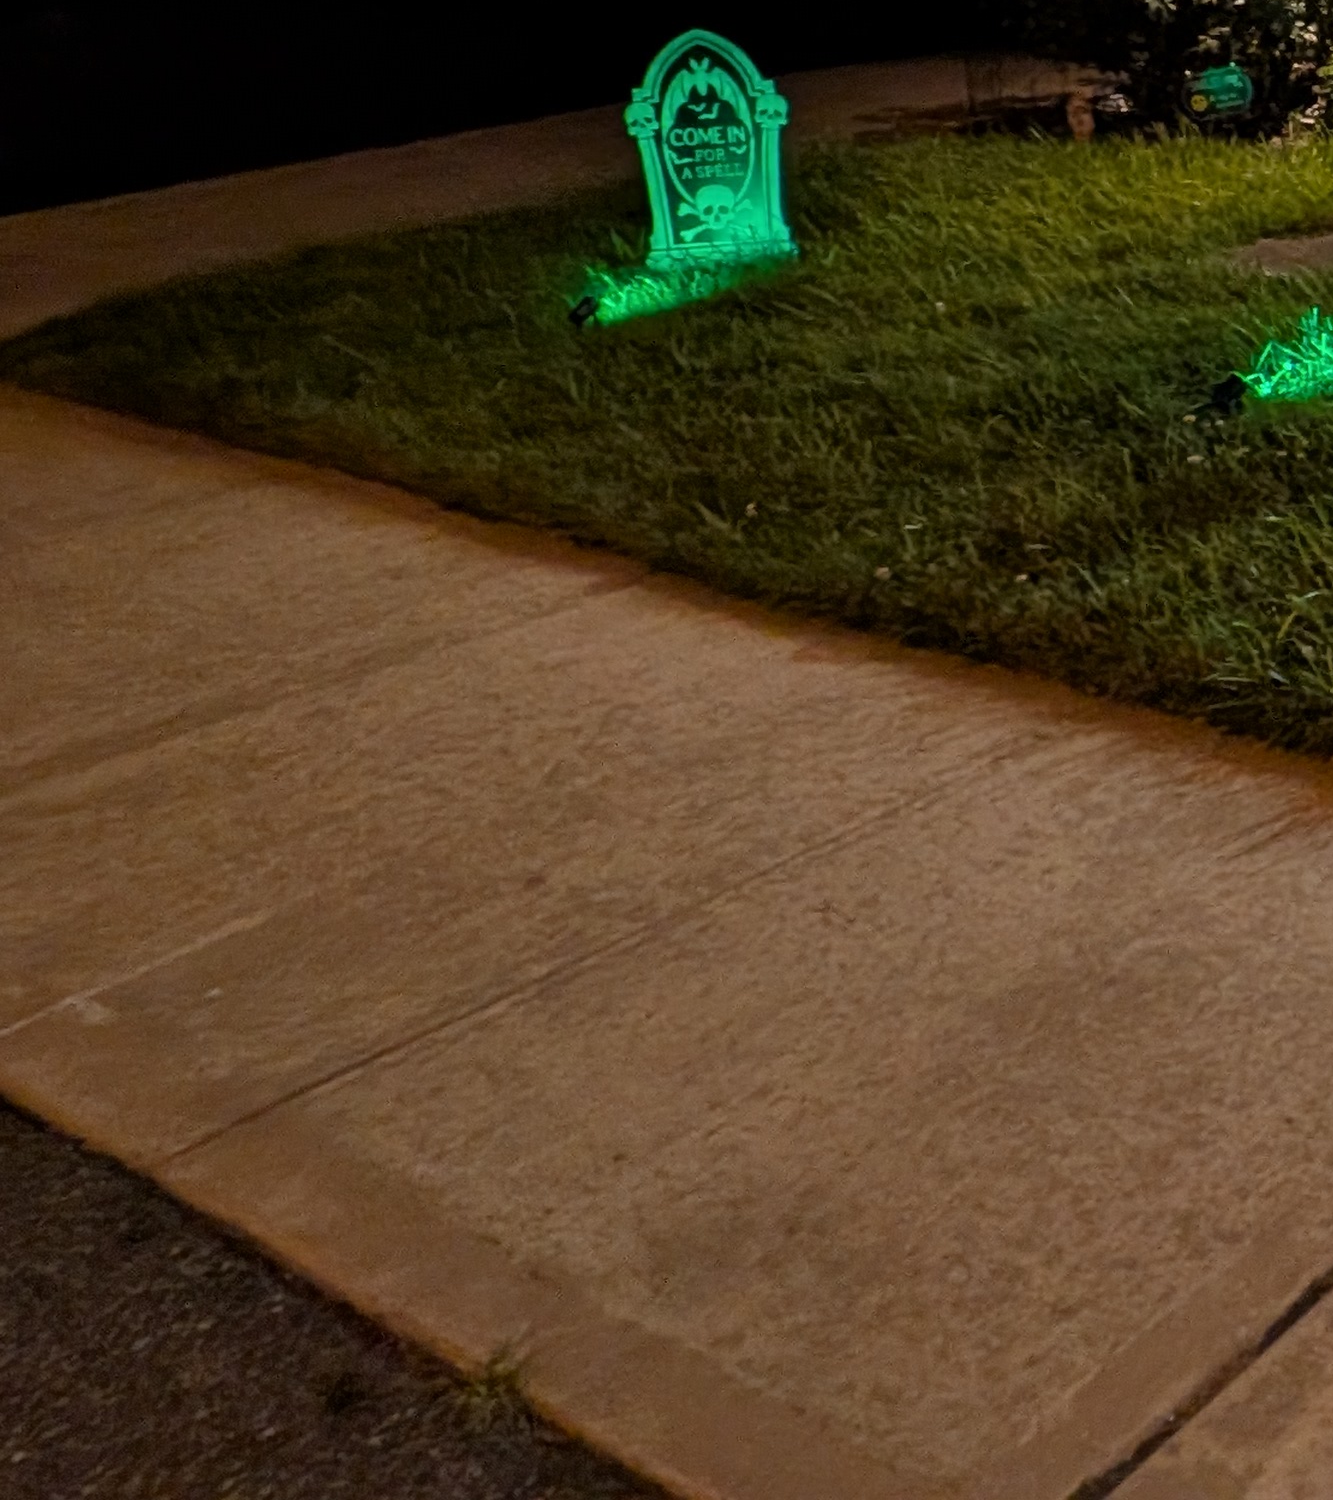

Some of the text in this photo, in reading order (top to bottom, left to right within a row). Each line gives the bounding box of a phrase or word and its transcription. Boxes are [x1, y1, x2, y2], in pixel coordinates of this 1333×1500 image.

[669, 125, 746, 147] COME IN
[695, 148, 726, 162] FOR
[681, 162, 745, 180] A SPELL
